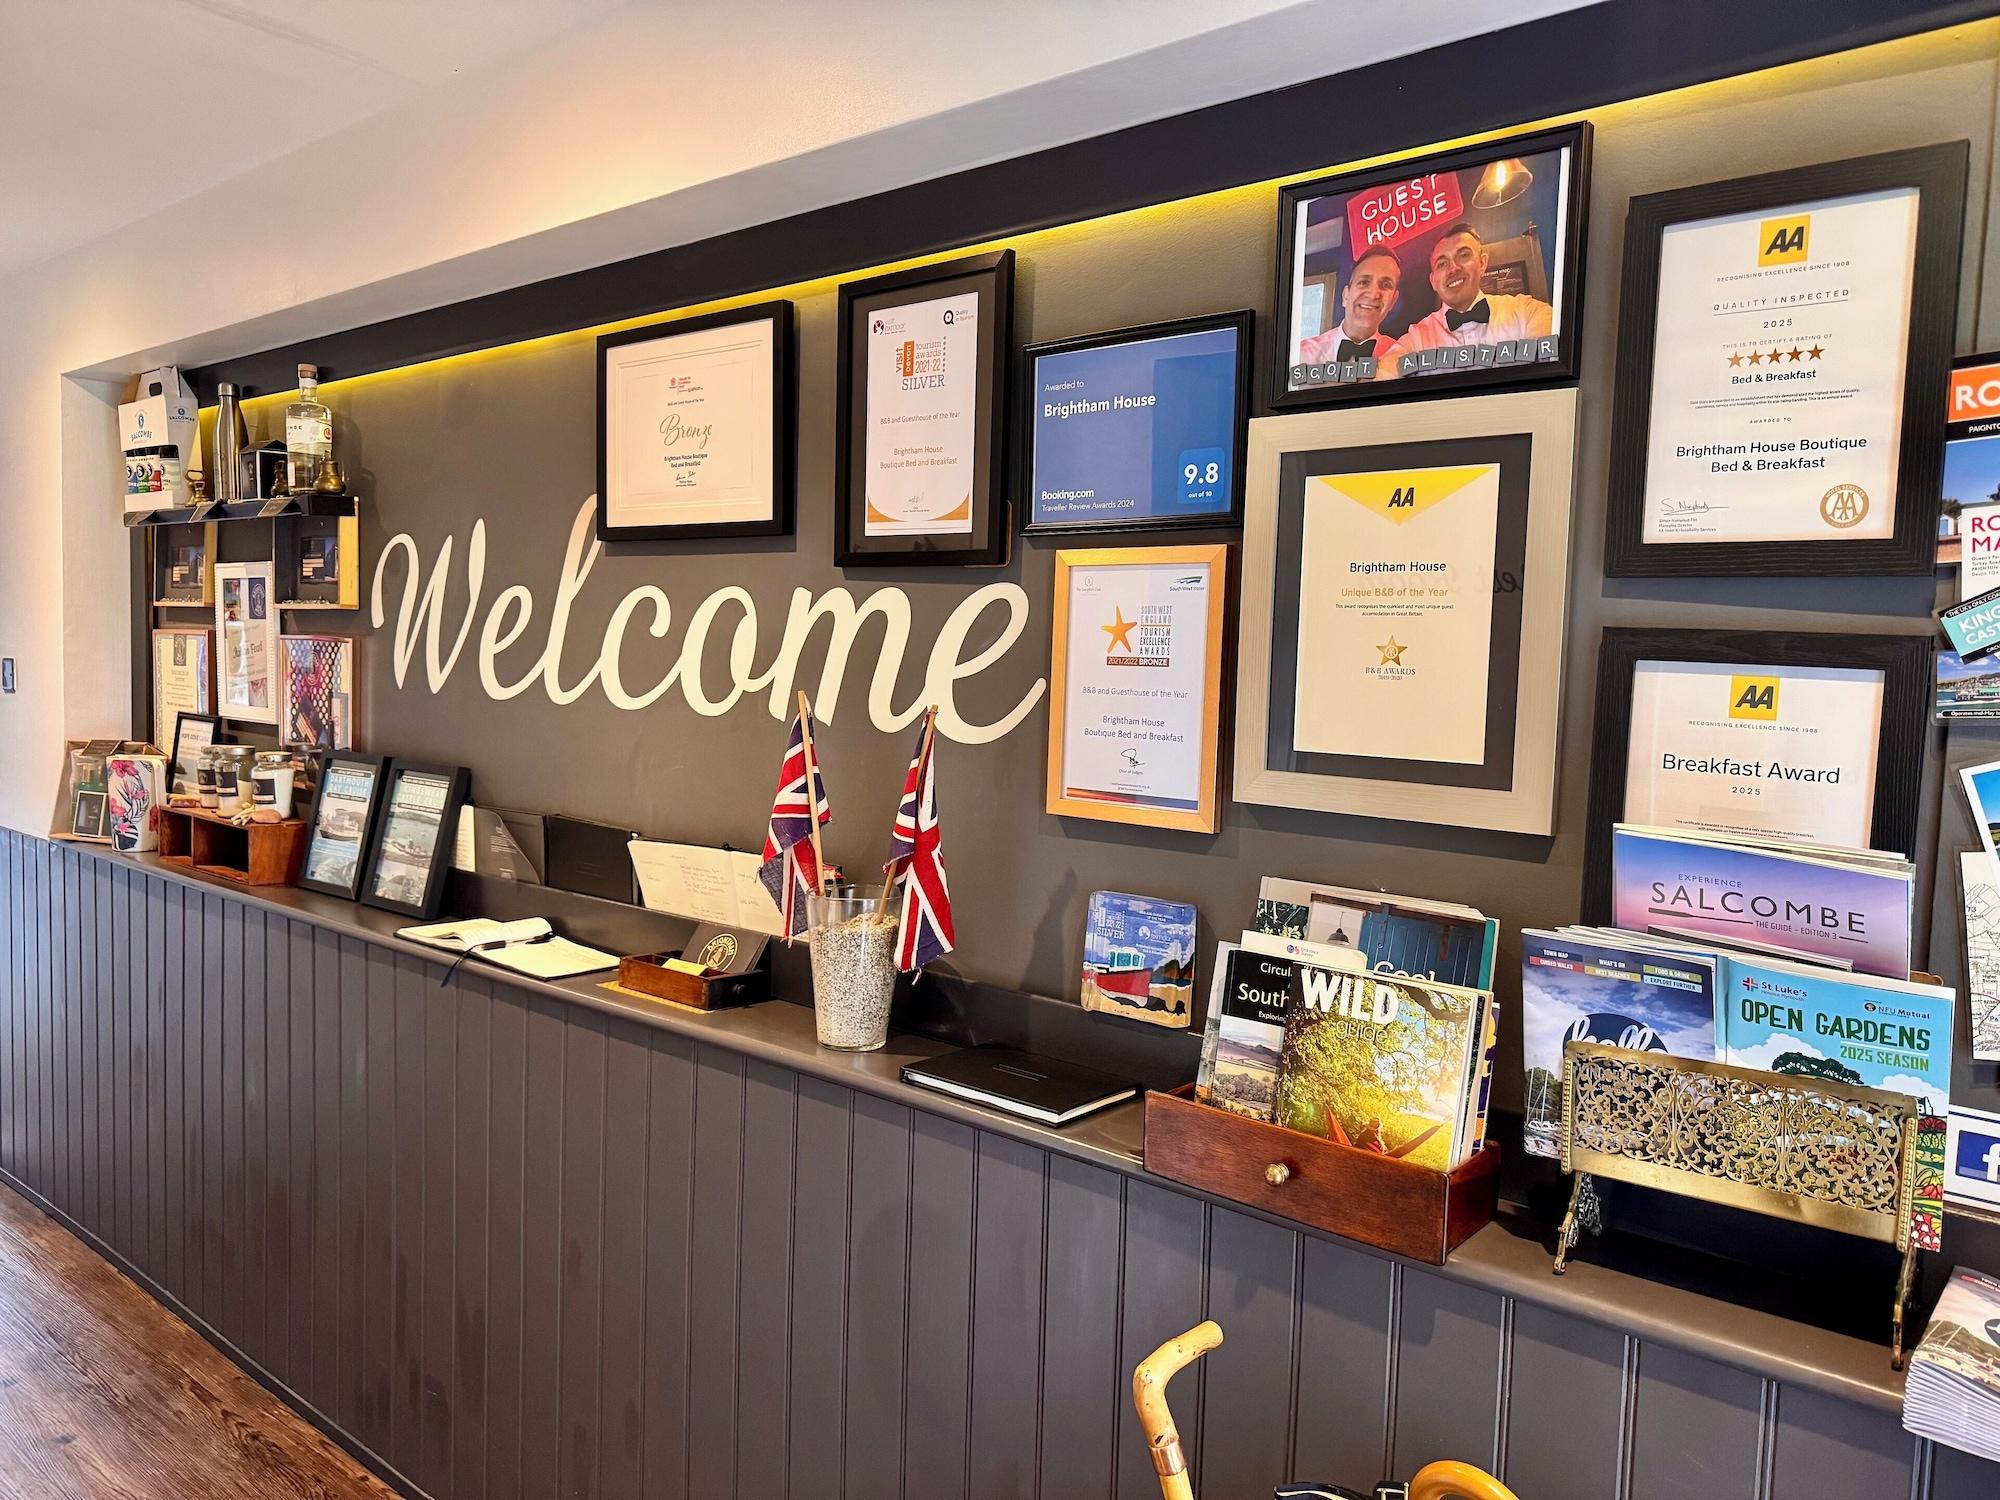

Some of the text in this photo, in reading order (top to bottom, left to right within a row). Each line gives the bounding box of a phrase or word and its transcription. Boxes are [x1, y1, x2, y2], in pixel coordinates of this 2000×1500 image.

[1361, 173, 1439, 221] GUEST
[1366, 192, 1447, 245] HOUSE
[1764, 226, 1804, 256] AA
[1717, 260, 1850, 282] RECOGNISING EXCELLENCE SINCE 1908
[1713, 289, 1849, 311] QUALITY INSPECTED
[1763, 318, 1793, 329] 2025
[915, 340, 942, 350] tourism
[1759, 338, 1787, 346] CERTIFY
[1795, 334, 1821, 342] RATING
[915, 348, 942, 359] awards
[1403, 341, 1554, 369] ALISTAIR
[1294, 361, 1370, 379] SCOTT
[1732, 369, 1817, 385] Bed & Breakfast
[901, 374, 945, 391] SILVER
[1044, 380, 1085, 392] Awarded to
[1044, 393, 1157, 419] Brightham House
[891, 416, 901, 424] and
[901, 413, 932, 424] Guesthouse
[932, 412, 940, 421] of
[939, 412, 949, 420] the
[948, 411, 961, 419] Year
[659, 413, 713, 450] Bronze
[893, 445, 944, 457] Brightham House
[1676, 437, 1868, 459] Brightham House Boutique
[879, 456, 958, 470] Boutique Bed and Breakfast
[1711, 455, 1826, 473] Bed & Breakfast
[1184, 462, 1219, 485] 9.8
[1041, 488, 1095, 501] Booking.com
[1387, 487, 1415, 508] AA
[1041, 499, 1135, 512] Traveller Review Awards 2024
[1349, 560, 1447, 575] Brightham House
[1341, 587, 1449, 599] Unique B&B of the Year
[1141, 605, 1173, 615] SOUTH WEST
[371, 494, 1046, 745] Welcome
[1140, 615, 1172, 625] ENGLAND
[1140, 627, 1171, 637] TOURISM
[1139, 637, 1171, 646] EXCELLENCE
[1139, 646, 1171, 656] AWARDS
[1138, 658, 1168, 667] BRONZE
[1365, 666, 1416, 676] B&B AWARDS
[1082, 686, 1189, 699] B&B and Guesthouse of the Year
[1734, 685, 1774, 710] AA
[1102, 715, 1165, 728] Brightham House
[1688, 720, 1733, 728] RECOGNISING
[1735, 723, 1777, 731] EXCELLENCE
[1084, 727, 1184, 743] Boutique Bed and Breakfast
[1662, 752, 1841, 785] Breakfast Award
[1732, 786, 1762, 796] 2025
[1677, 873, 1743, 888] EXPERIENCE
[1651, 881, 1865, 934] SALCOMBE
[1096, 926, 1125, 940] SILVER
[1755, 920, 1838, 940] THE GUIDE EDITION 3
[1543, 949, 1569, 959] TOWN MAP
[1558, 961, 1574, 970] WALKS
[1598, 959, 1626, 969] WHAT'S ON
[1654, 967, 1669, 976] FOOD
[1673, 970, 1690, 980] DRINK
[1649, 976, 1696, 991] EXPLORE FURTHER
[1761, 982, 1808, 998] St Luke's
[1300, 968, 1400, 1025] WILD
[1877, 1005, 1931, 1020] NFU Mutual
[1335, 1018, 1388, 1045] guide
[1741, 998, 1931, 1052] OPEN GARDENS
[1839, 1044, 1929, 1073] 2025 SEASON
